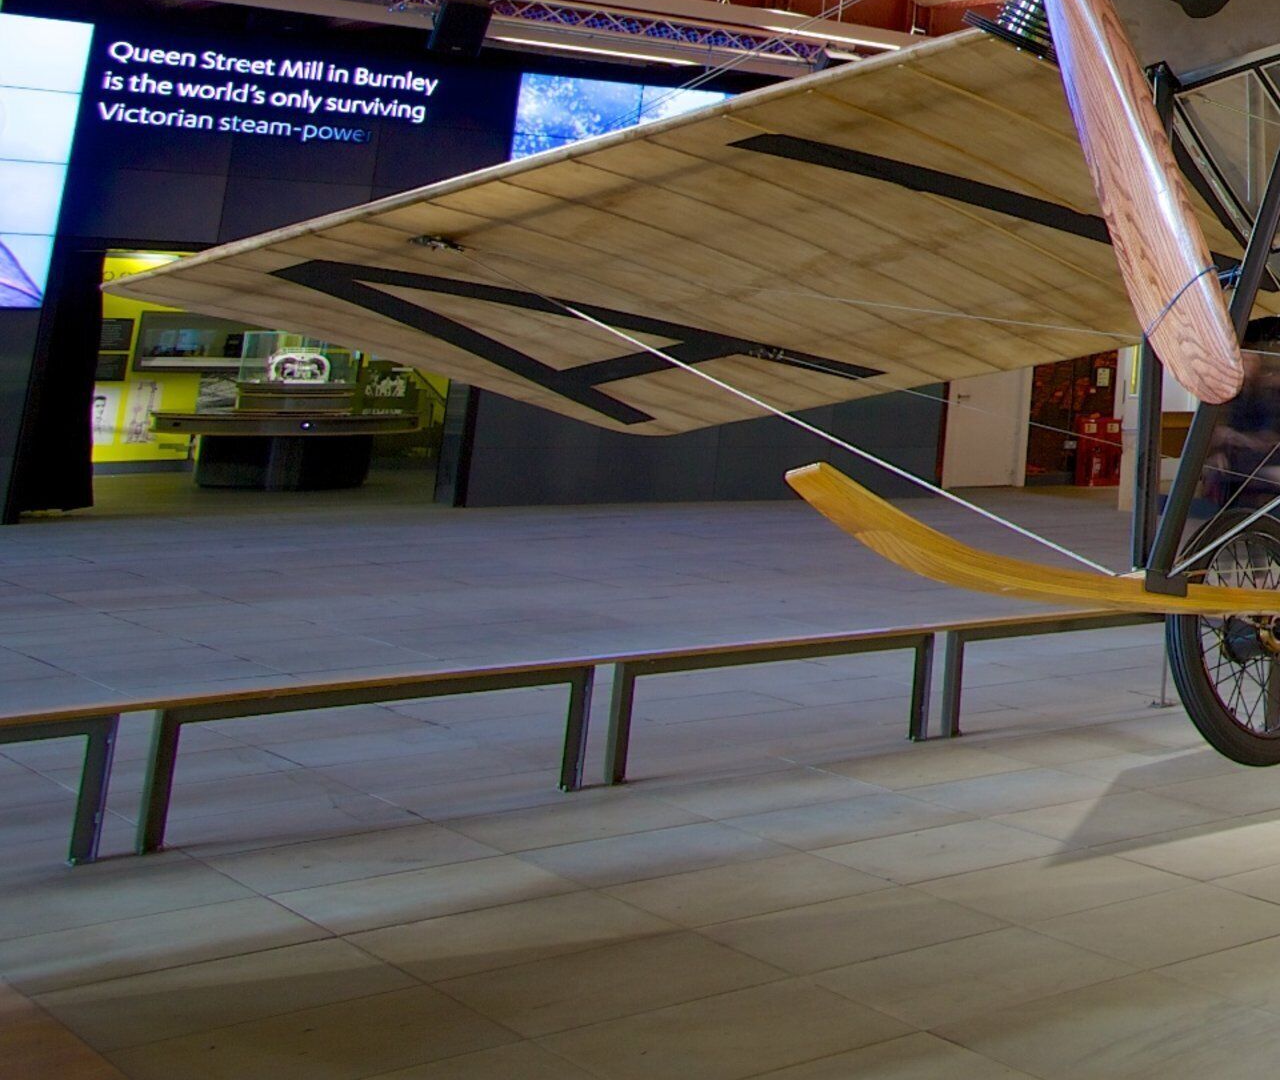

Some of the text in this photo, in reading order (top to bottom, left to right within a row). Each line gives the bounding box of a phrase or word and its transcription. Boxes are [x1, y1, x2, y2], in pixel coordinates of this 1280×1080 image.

[108, 41, 438, 96] Queen Street Mill in Burnley
[98, 102, 213, 130] Victorian
[102, 71, 426, 123] is the world's only surviving
